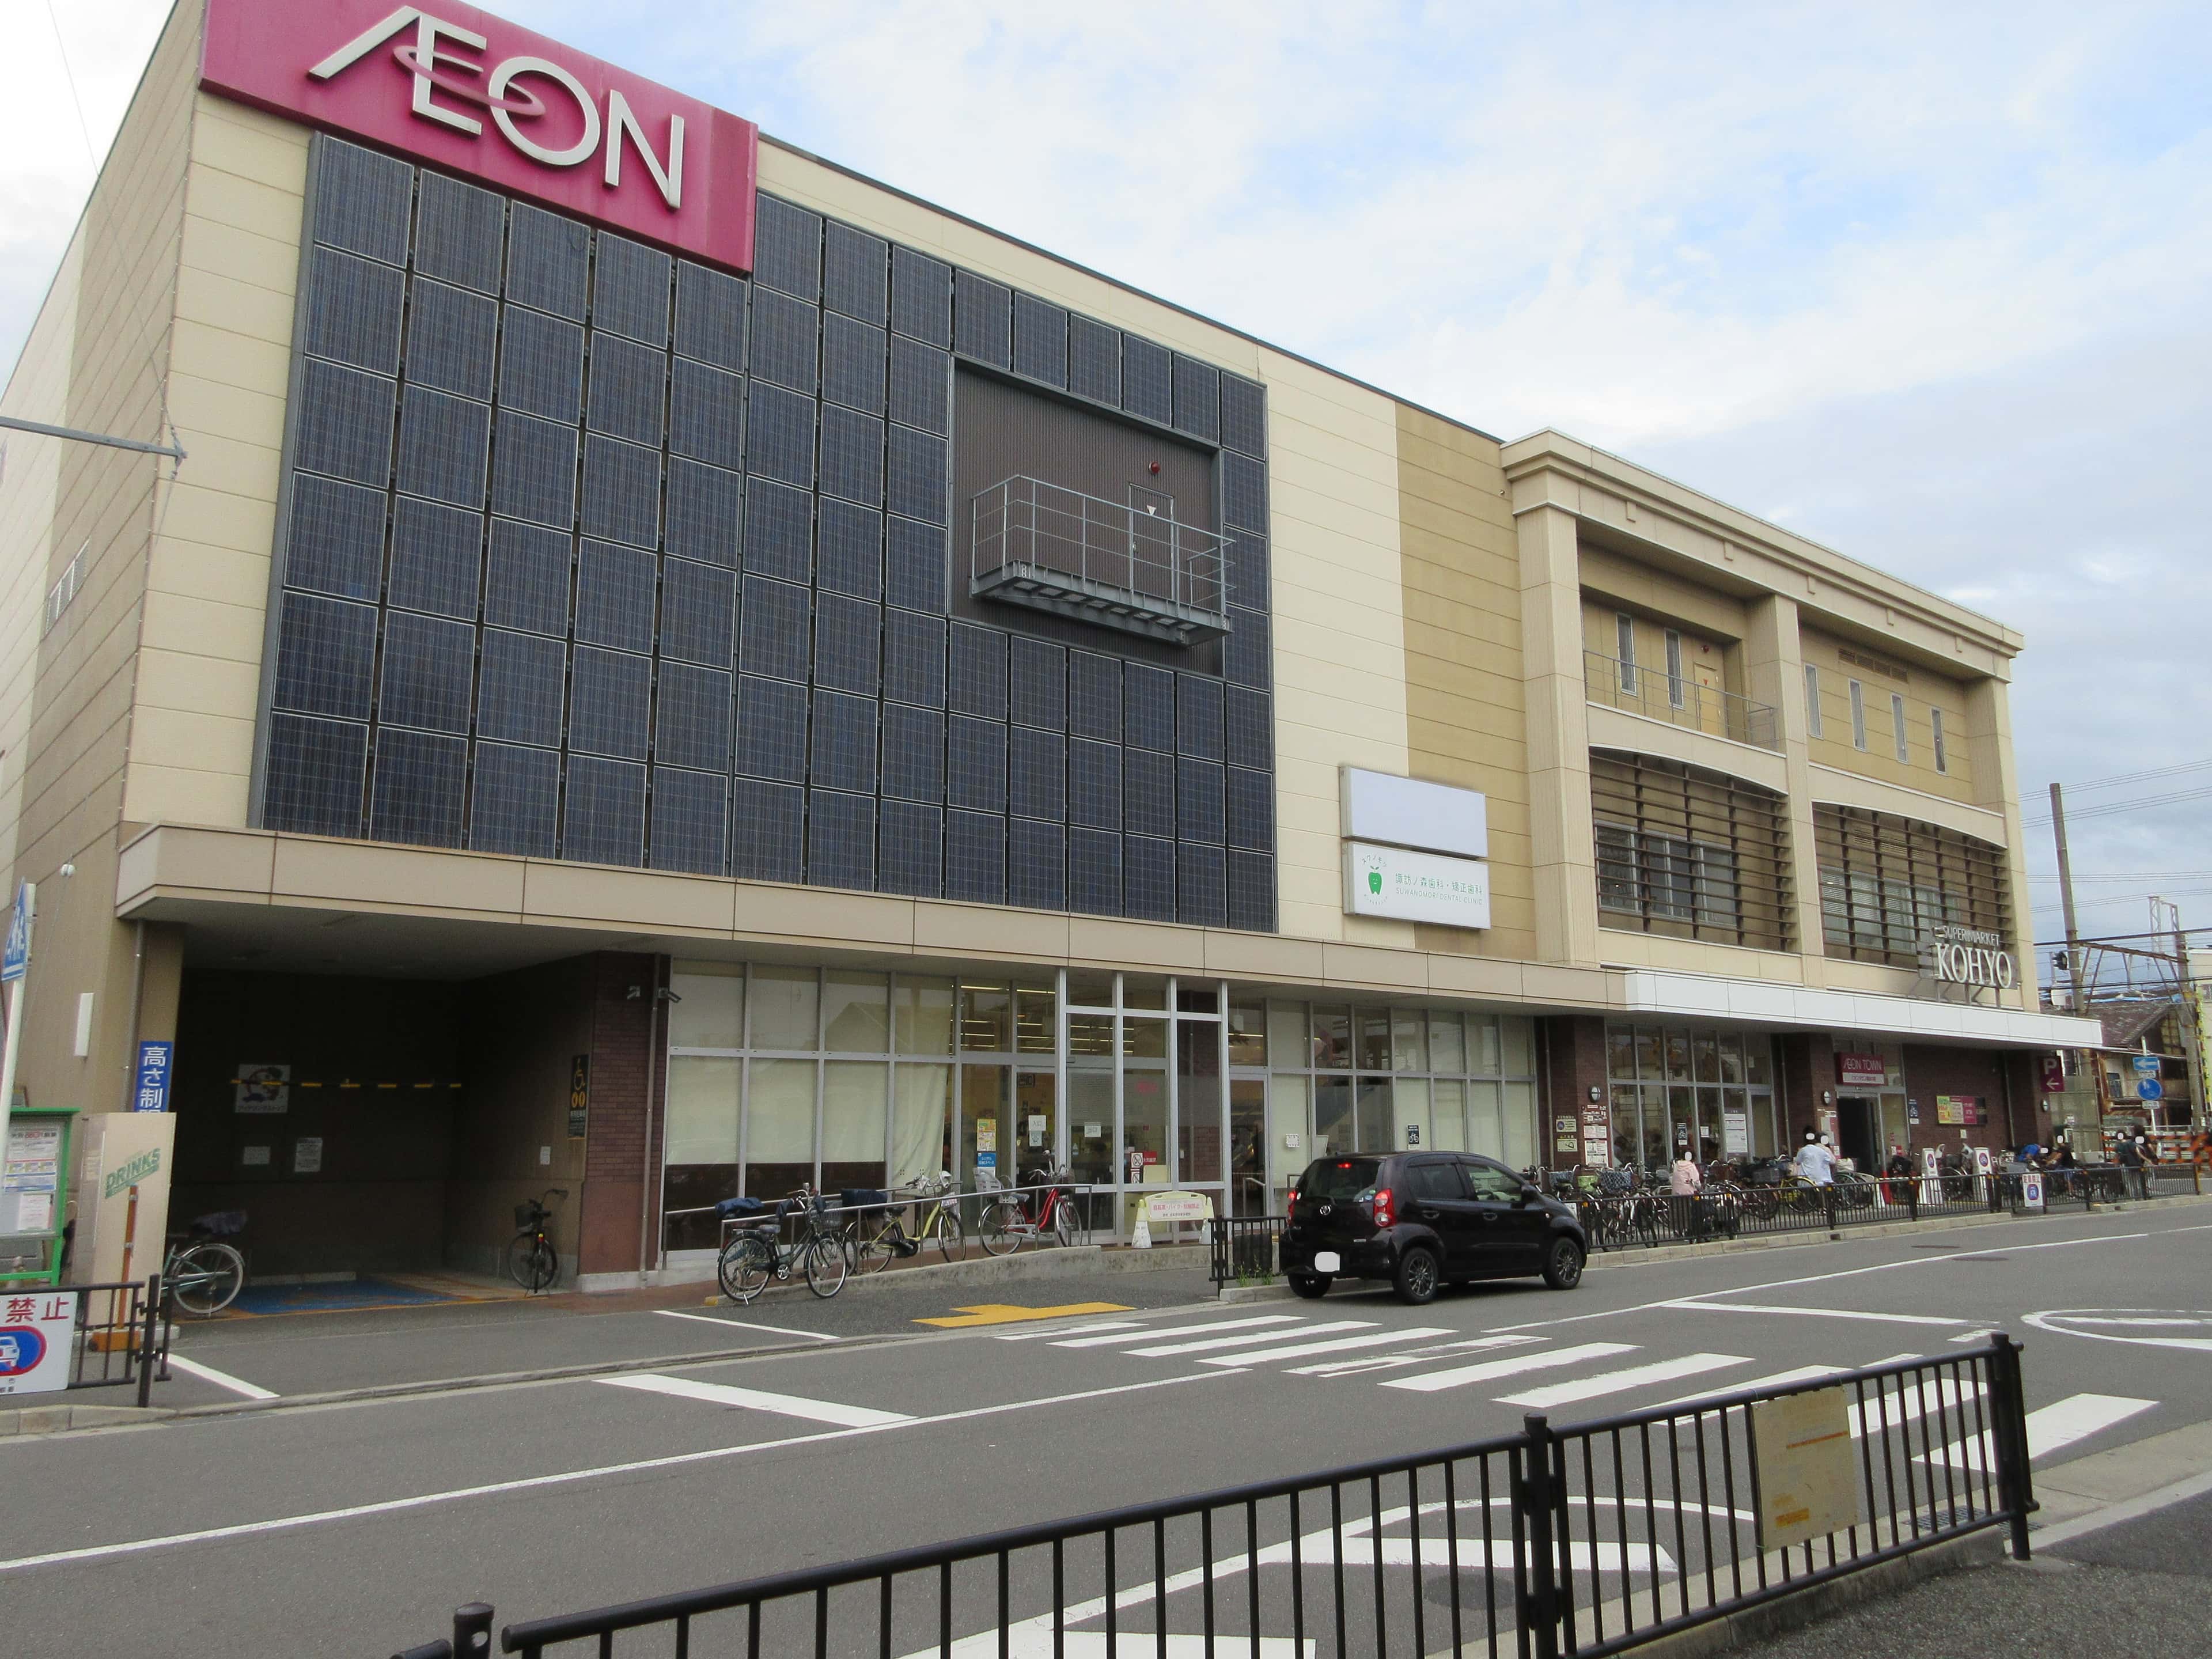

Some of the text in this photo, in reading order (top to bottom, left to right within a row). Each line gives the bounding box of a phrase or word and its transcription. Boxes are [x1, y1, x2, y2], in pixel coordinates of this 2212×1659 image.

[1396, 887, 1438, 899] SUWANOMORI
[1440, 893, 1461, 903] DENTAL
[1464, 896, 1483, 906] CLINIC
[1942, 926, 2000, 946] SUPERMARKET
[1935, 942, 2012, 988] KOHYO
[1862, 1059, 1882, 1071] TOWN
[2045, 1058, 2057, 1074] P
[139, 1046, 168, 1112] 高さ制
[106, 1148, 161, 1191] DRINKS
